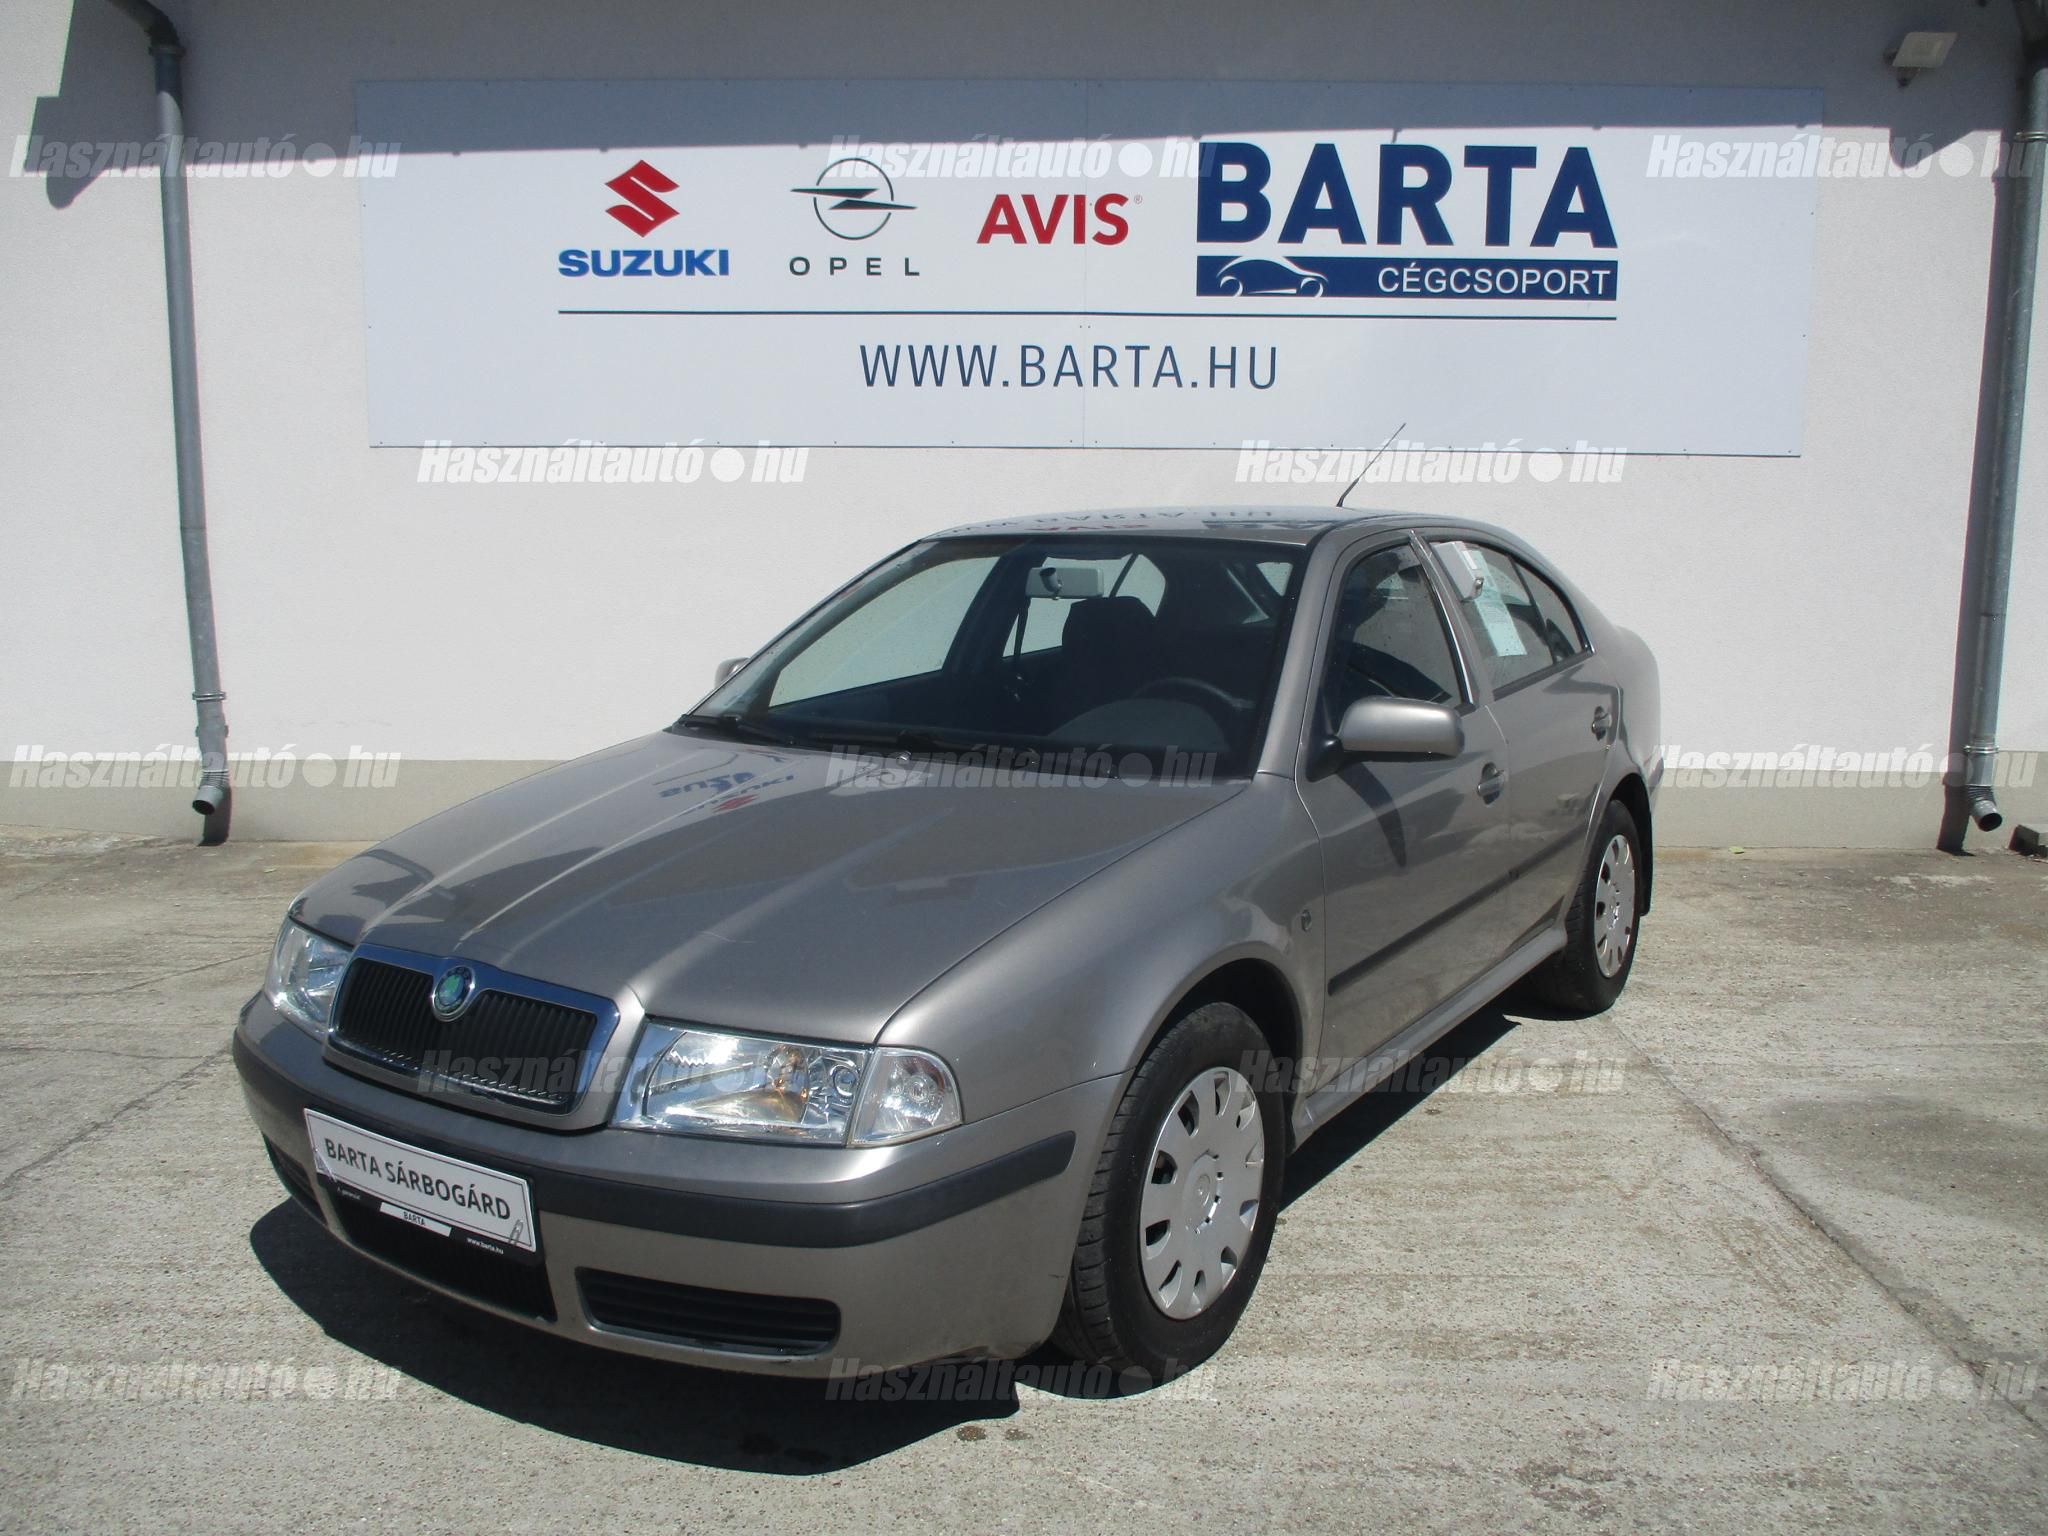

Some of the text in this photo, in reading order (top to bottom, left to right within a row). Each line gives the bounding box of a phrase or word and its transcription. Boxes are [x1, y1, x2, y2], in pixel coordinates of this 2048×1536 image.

[1197, 142, 1617, 248] BARTA
[977, 193, 1128, 246] AVIS
[558, 249, 729, 277] SUZUKI
[789, 256, 920, 276] OPEL
[1377, 261, 1612, 296] CÉGCSOPORT
[859, 344, 1277, 390] WWW.BARTA.HU
[325, 1138, 511, 1220] BARTA SÁRBOGÁRD
[403, 1211, 426, 1226] BARTA
